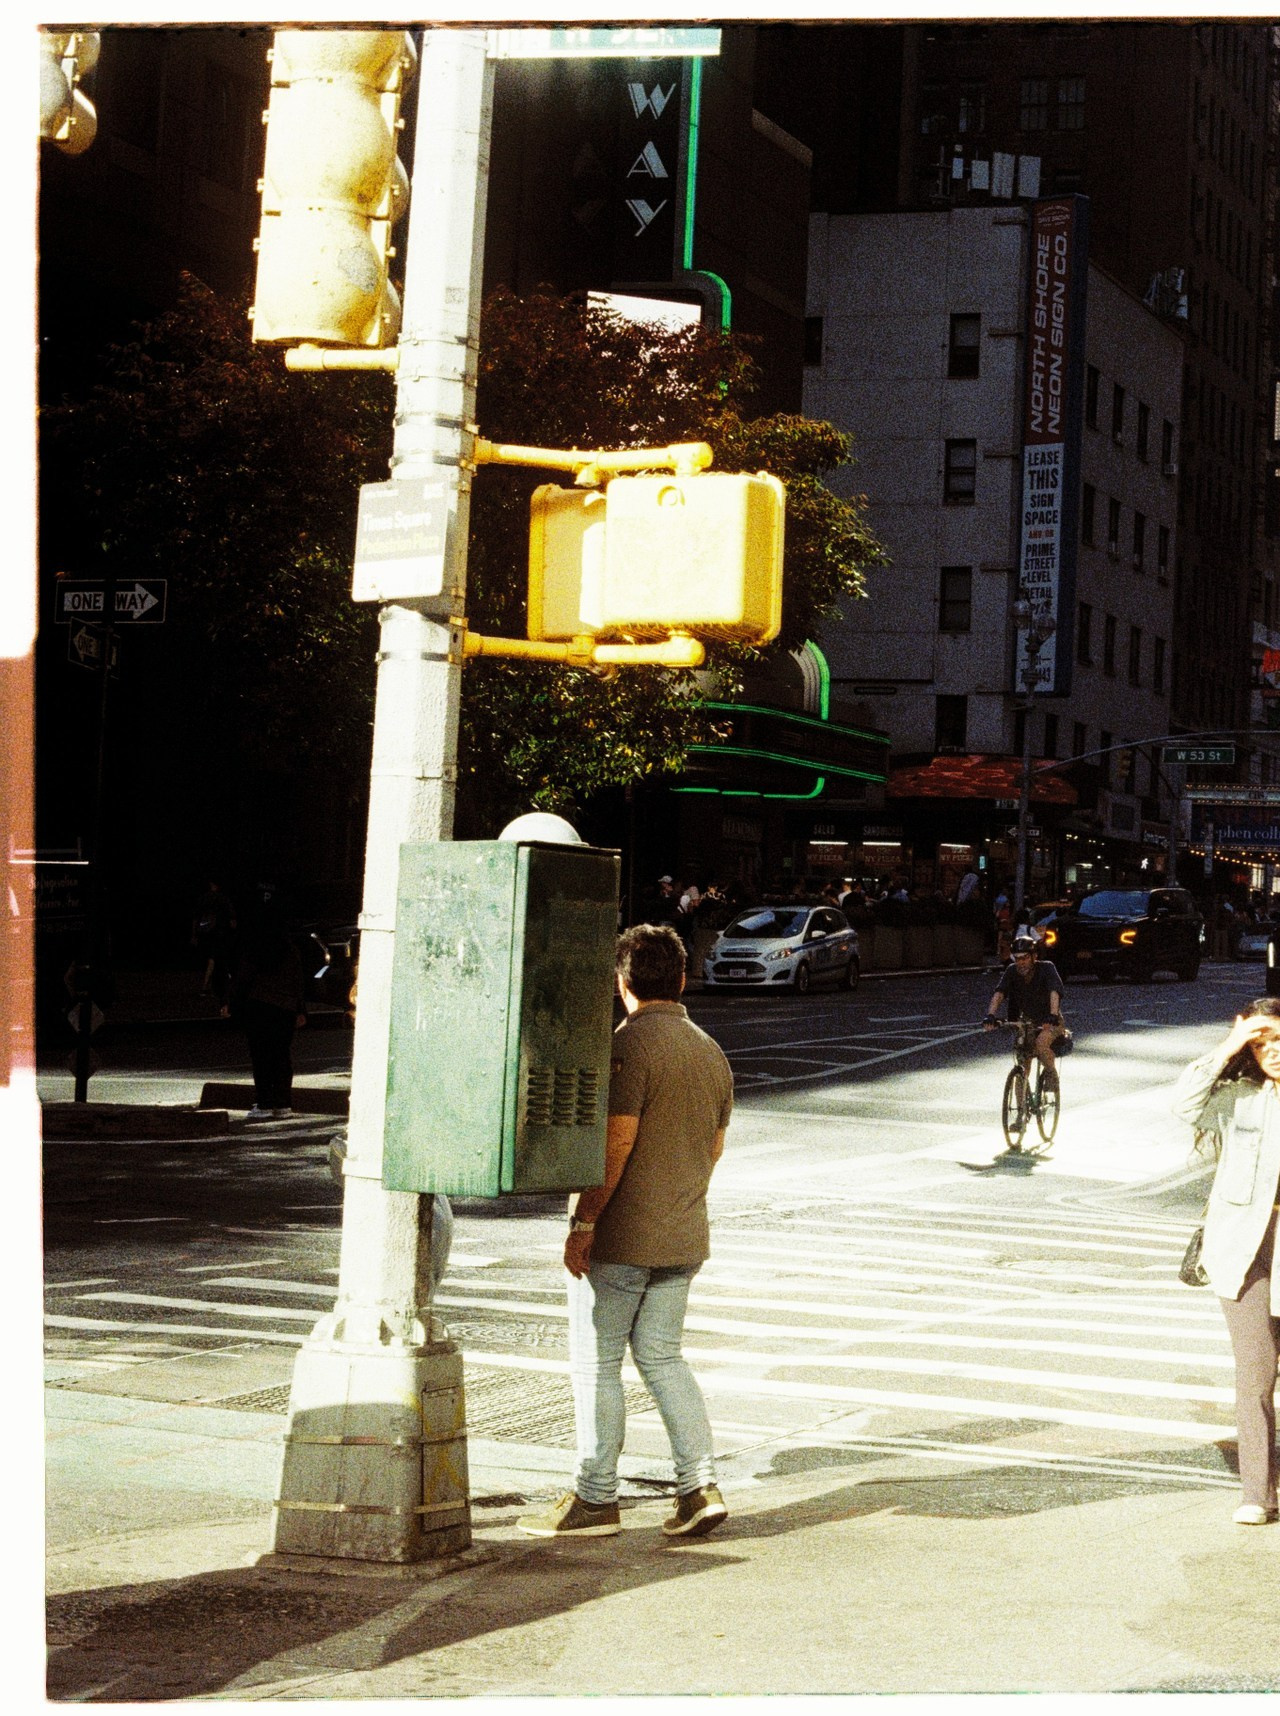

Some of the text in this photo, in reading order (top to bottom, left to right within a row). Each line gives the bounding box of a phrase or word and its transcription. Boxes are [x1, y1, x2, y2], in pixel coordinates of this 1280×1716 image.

[625, 56, 676, 237] WAY
[1054, 231, 1068, 276] CO.
[1050, 281, 1066, 349] SIGN
[1030, 232, 1050, 434] NORTH SHORE
[1047, 353, 1063, 435] NEON
[1028, 451, 1060, 467] LEASE
[1028, 468, 1059, 490] THIS
[1030, 493, 1055, 508] SIGN
[1024, 510, 1059, 526] SPACE
[1026, 543, 1056, 558] PRIME
[1024, 557, 1056, 571] STREET
[72, 593, 148, 610] ONE WAY
[1176, 751, 1221, 761] W 53 St
